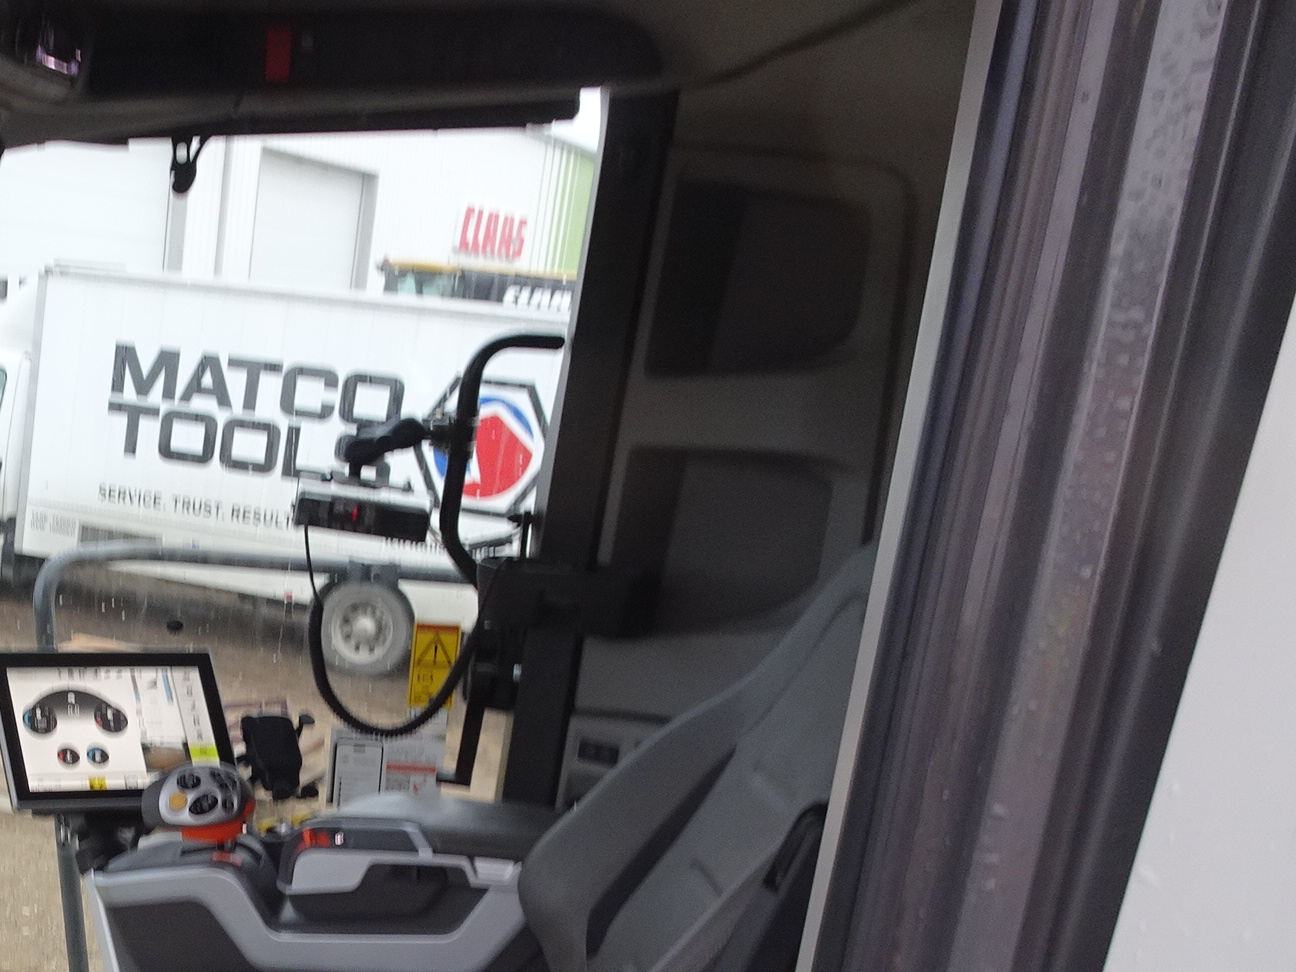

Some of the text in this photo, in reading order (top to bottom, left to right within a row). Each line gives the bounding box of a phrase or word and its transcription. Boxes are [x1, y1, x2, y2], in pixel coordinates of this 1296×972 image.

[459, 205, 528, 261] CLAAS
[110, 341, 405, 424] MATCO
[231, 504, 296, 533] RESULT
